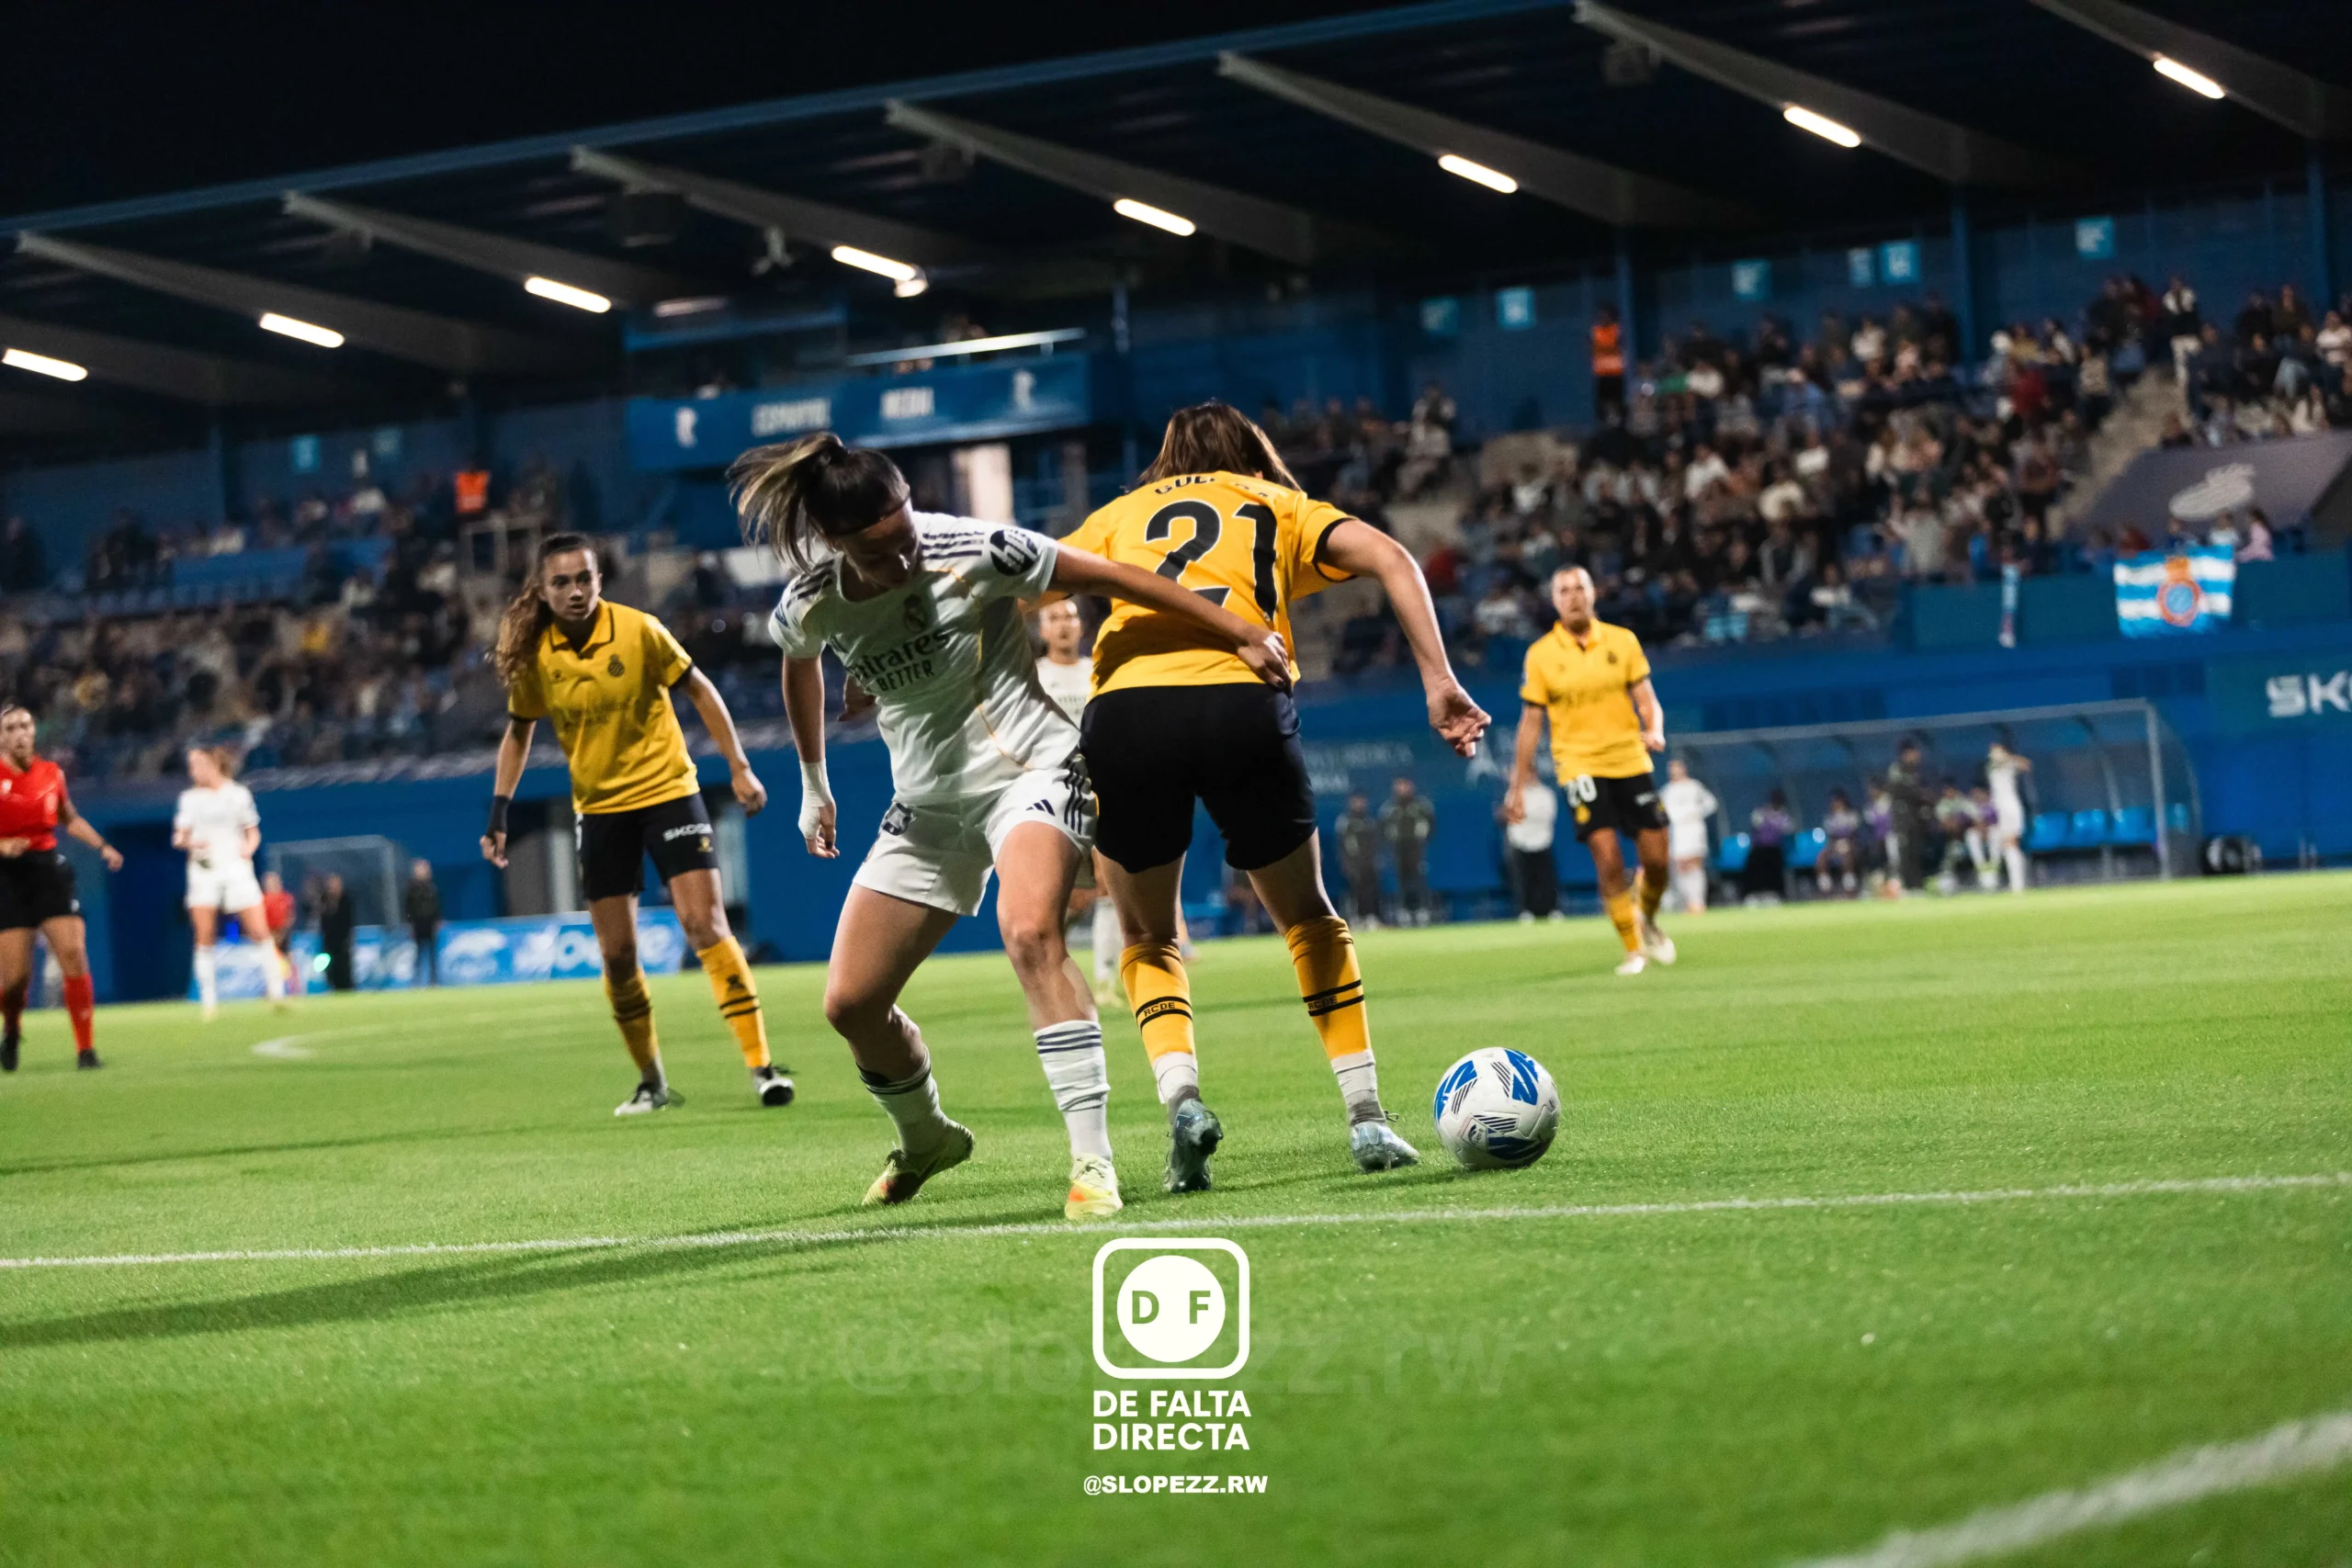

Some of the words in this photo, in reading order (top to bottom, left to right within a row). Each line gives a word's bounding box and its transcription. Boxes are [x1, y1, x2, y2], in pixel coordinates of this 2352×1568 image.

[1145, 499, 1278, 625] 21
[876, 660, 934, 692] BETTER
[2266, 670, 2352, 717] SK
